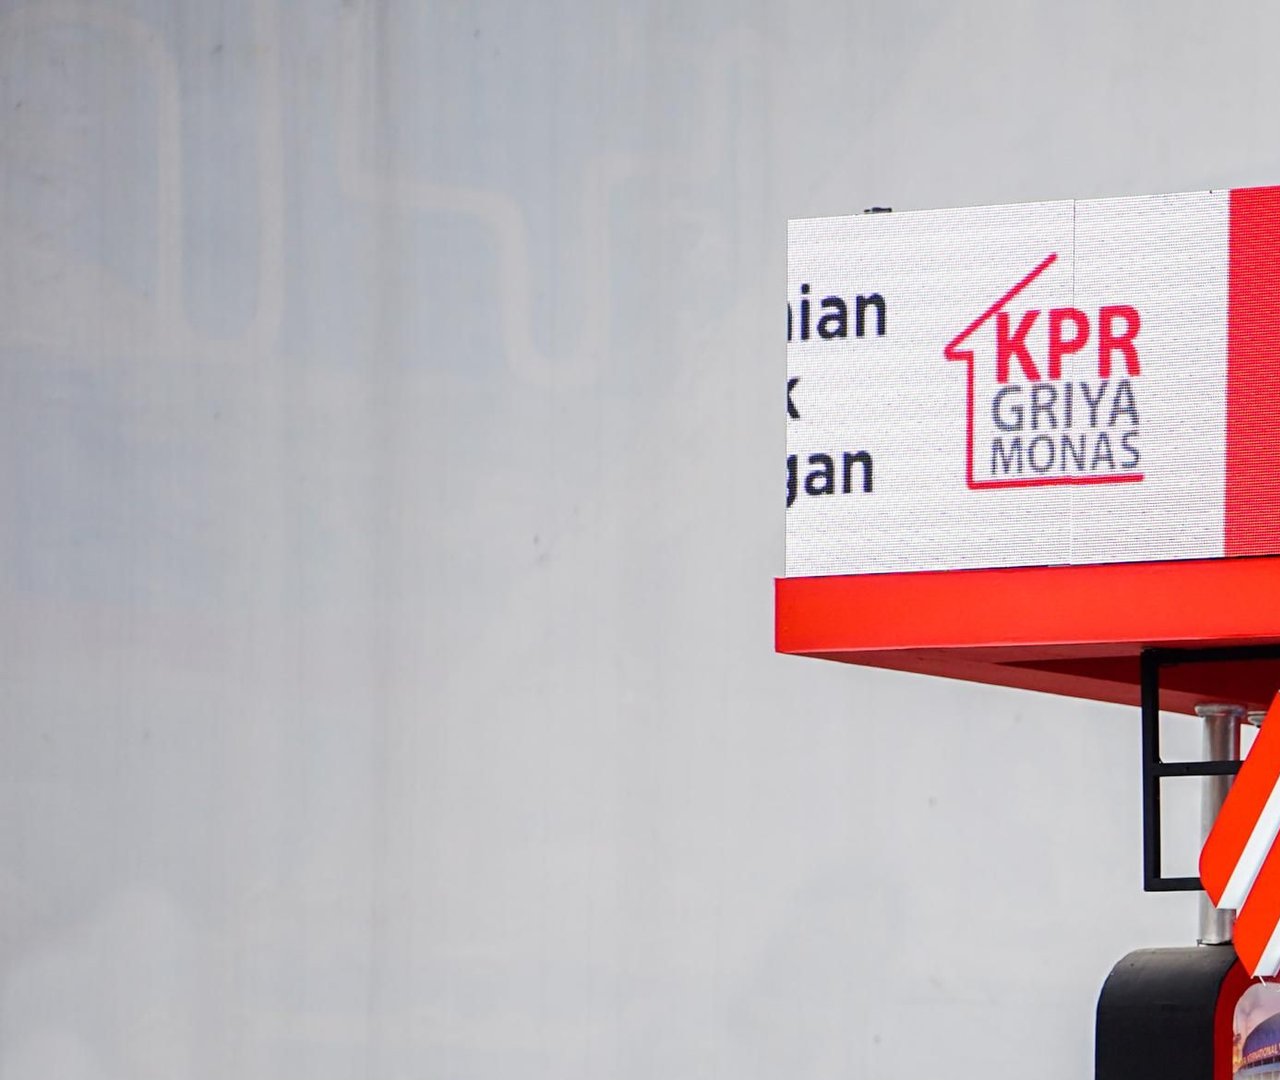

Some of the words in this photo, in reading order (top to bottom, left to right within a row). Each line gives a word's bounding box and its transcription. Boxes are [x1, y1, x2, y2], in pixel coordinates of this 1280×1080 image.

[786, 283, 887, 340] ian
[996, 305, 1141, 383] KPR
[991, 379, 1141, 432] GRIYA
[991, 430, 1141, 476] MONAS
